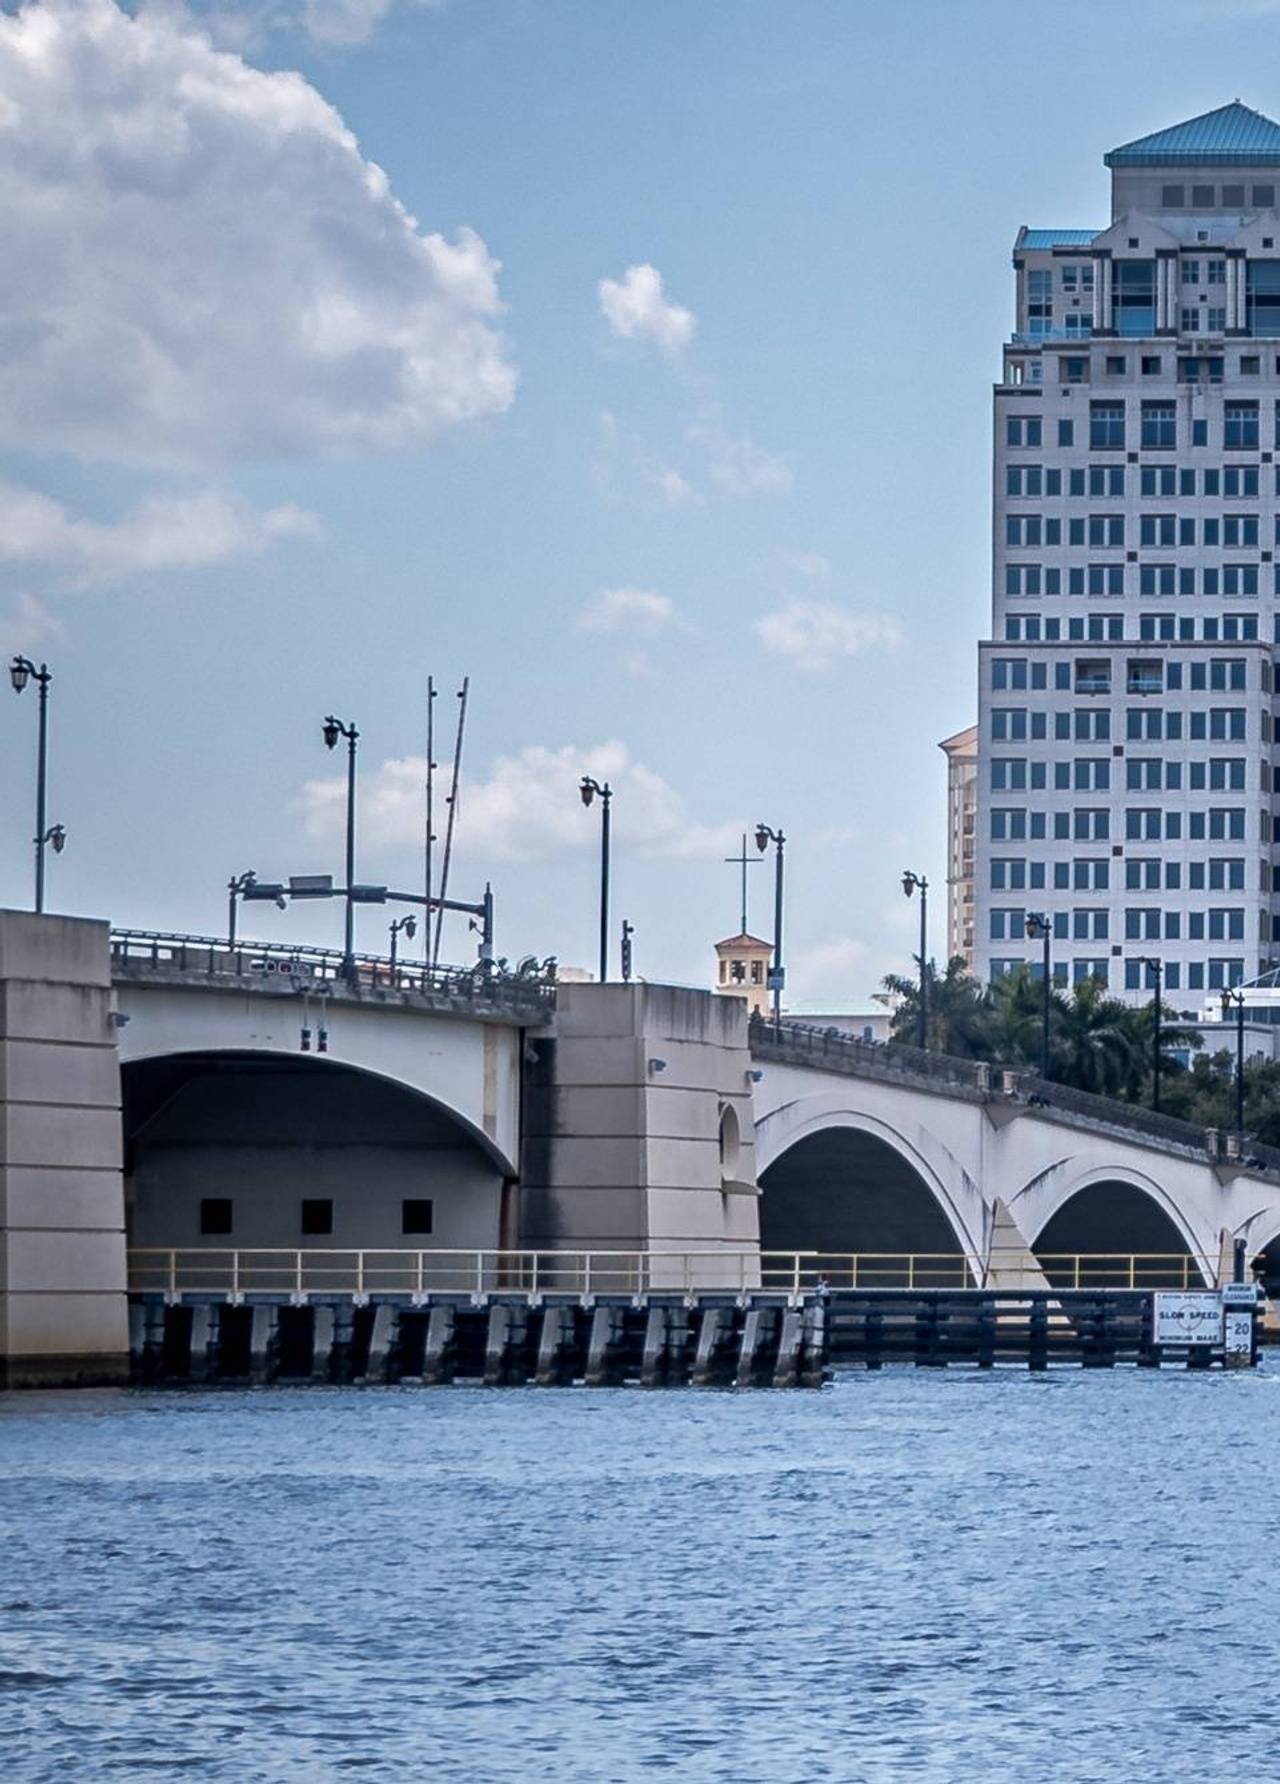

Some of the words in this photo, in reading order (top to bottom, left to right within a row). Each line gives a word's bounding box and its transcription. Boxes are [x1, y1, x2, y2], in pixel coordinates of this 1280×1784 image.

[1159, 1311, 1185, 1319] SLOW
[1189, 1311, 1220, 1319] SPEED
[1234, 1322, 1250, 1335] 20
